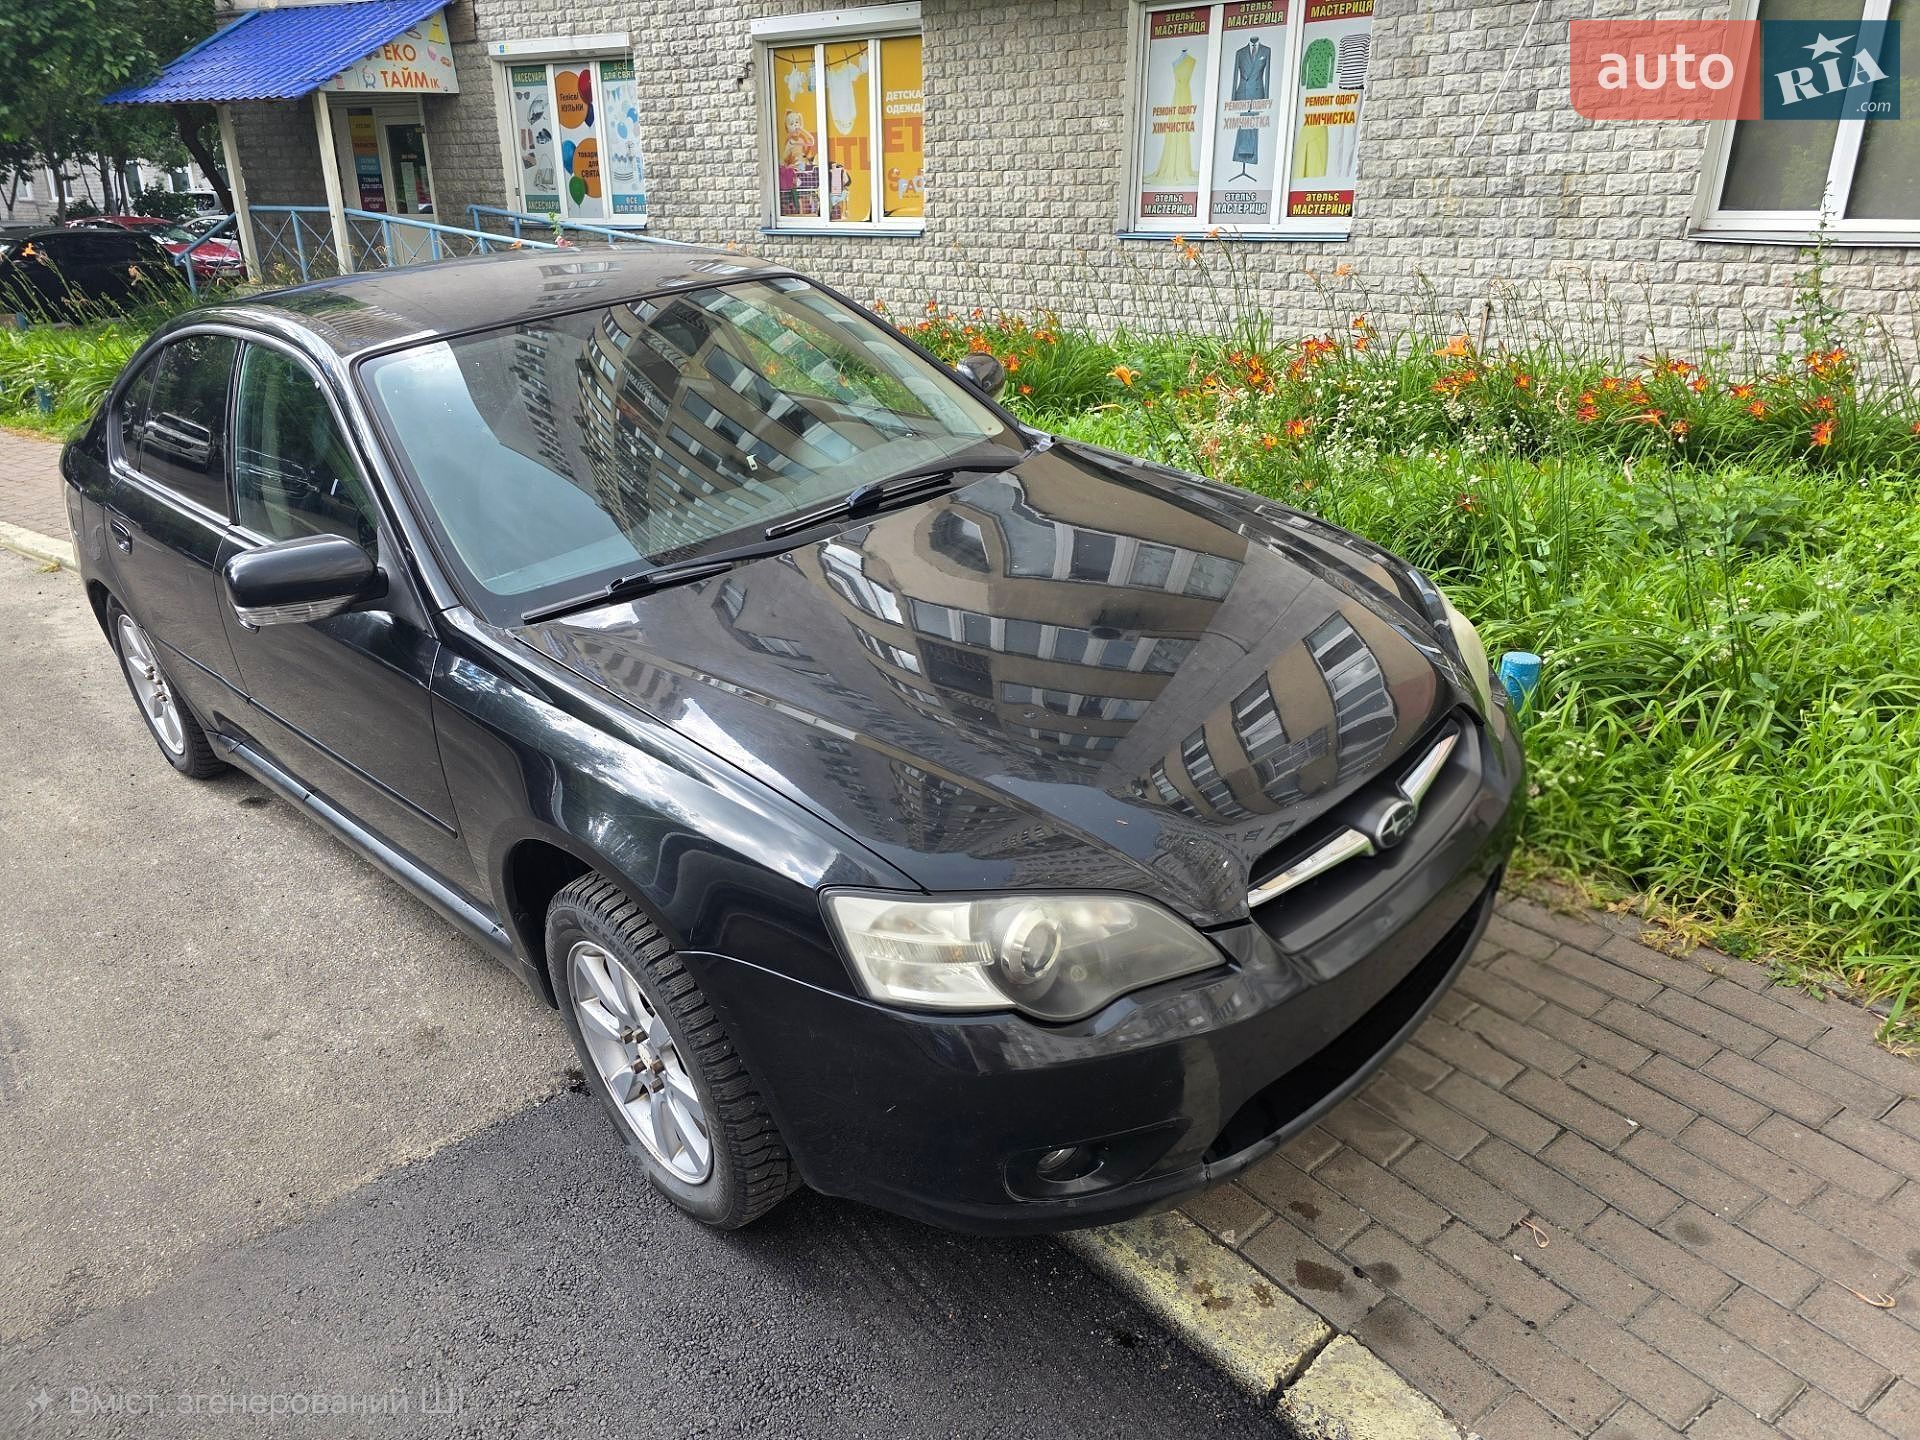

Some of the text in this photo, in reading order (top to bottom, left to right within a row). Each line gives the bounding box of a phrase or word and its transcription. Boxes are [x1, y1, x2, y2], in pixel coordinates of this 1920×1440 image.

[1311, 2, 1373, 18] МАСТЕРИЦЯ
[1227, 11, 1284, 27] МАСТЕРИЦЯ
[1154, 22, 1206, 36] МАСТЕРИЦЯ
[383, 44, 417, 62] ЕКО
[1305, 94, 1359, 107] РЕМОНТ ОДЯГУ
[1152, 104, 1197, 117] РЕМОНТ ОДЯГУ
[1224, 116, 1271, 130] ХІМЧИСТКА
[1304, 112, 1355, 126] ХІМЧИСТКА
[1152, 121, 1195, 134] ХІМЧИСТКА
[1155, 193, 1183, 202] ательє
[1225, 192, 1256, 202] ательє
[1305, 192, 1339, 202] ательє
[1144, 204, 1193, 215] МАСТЕРИЦЯ
[1213, 203, 1267, 215] МАСТЕРИЦЯ
[1292, 203, 1351, 215] МАСТЕРИЦЯ
